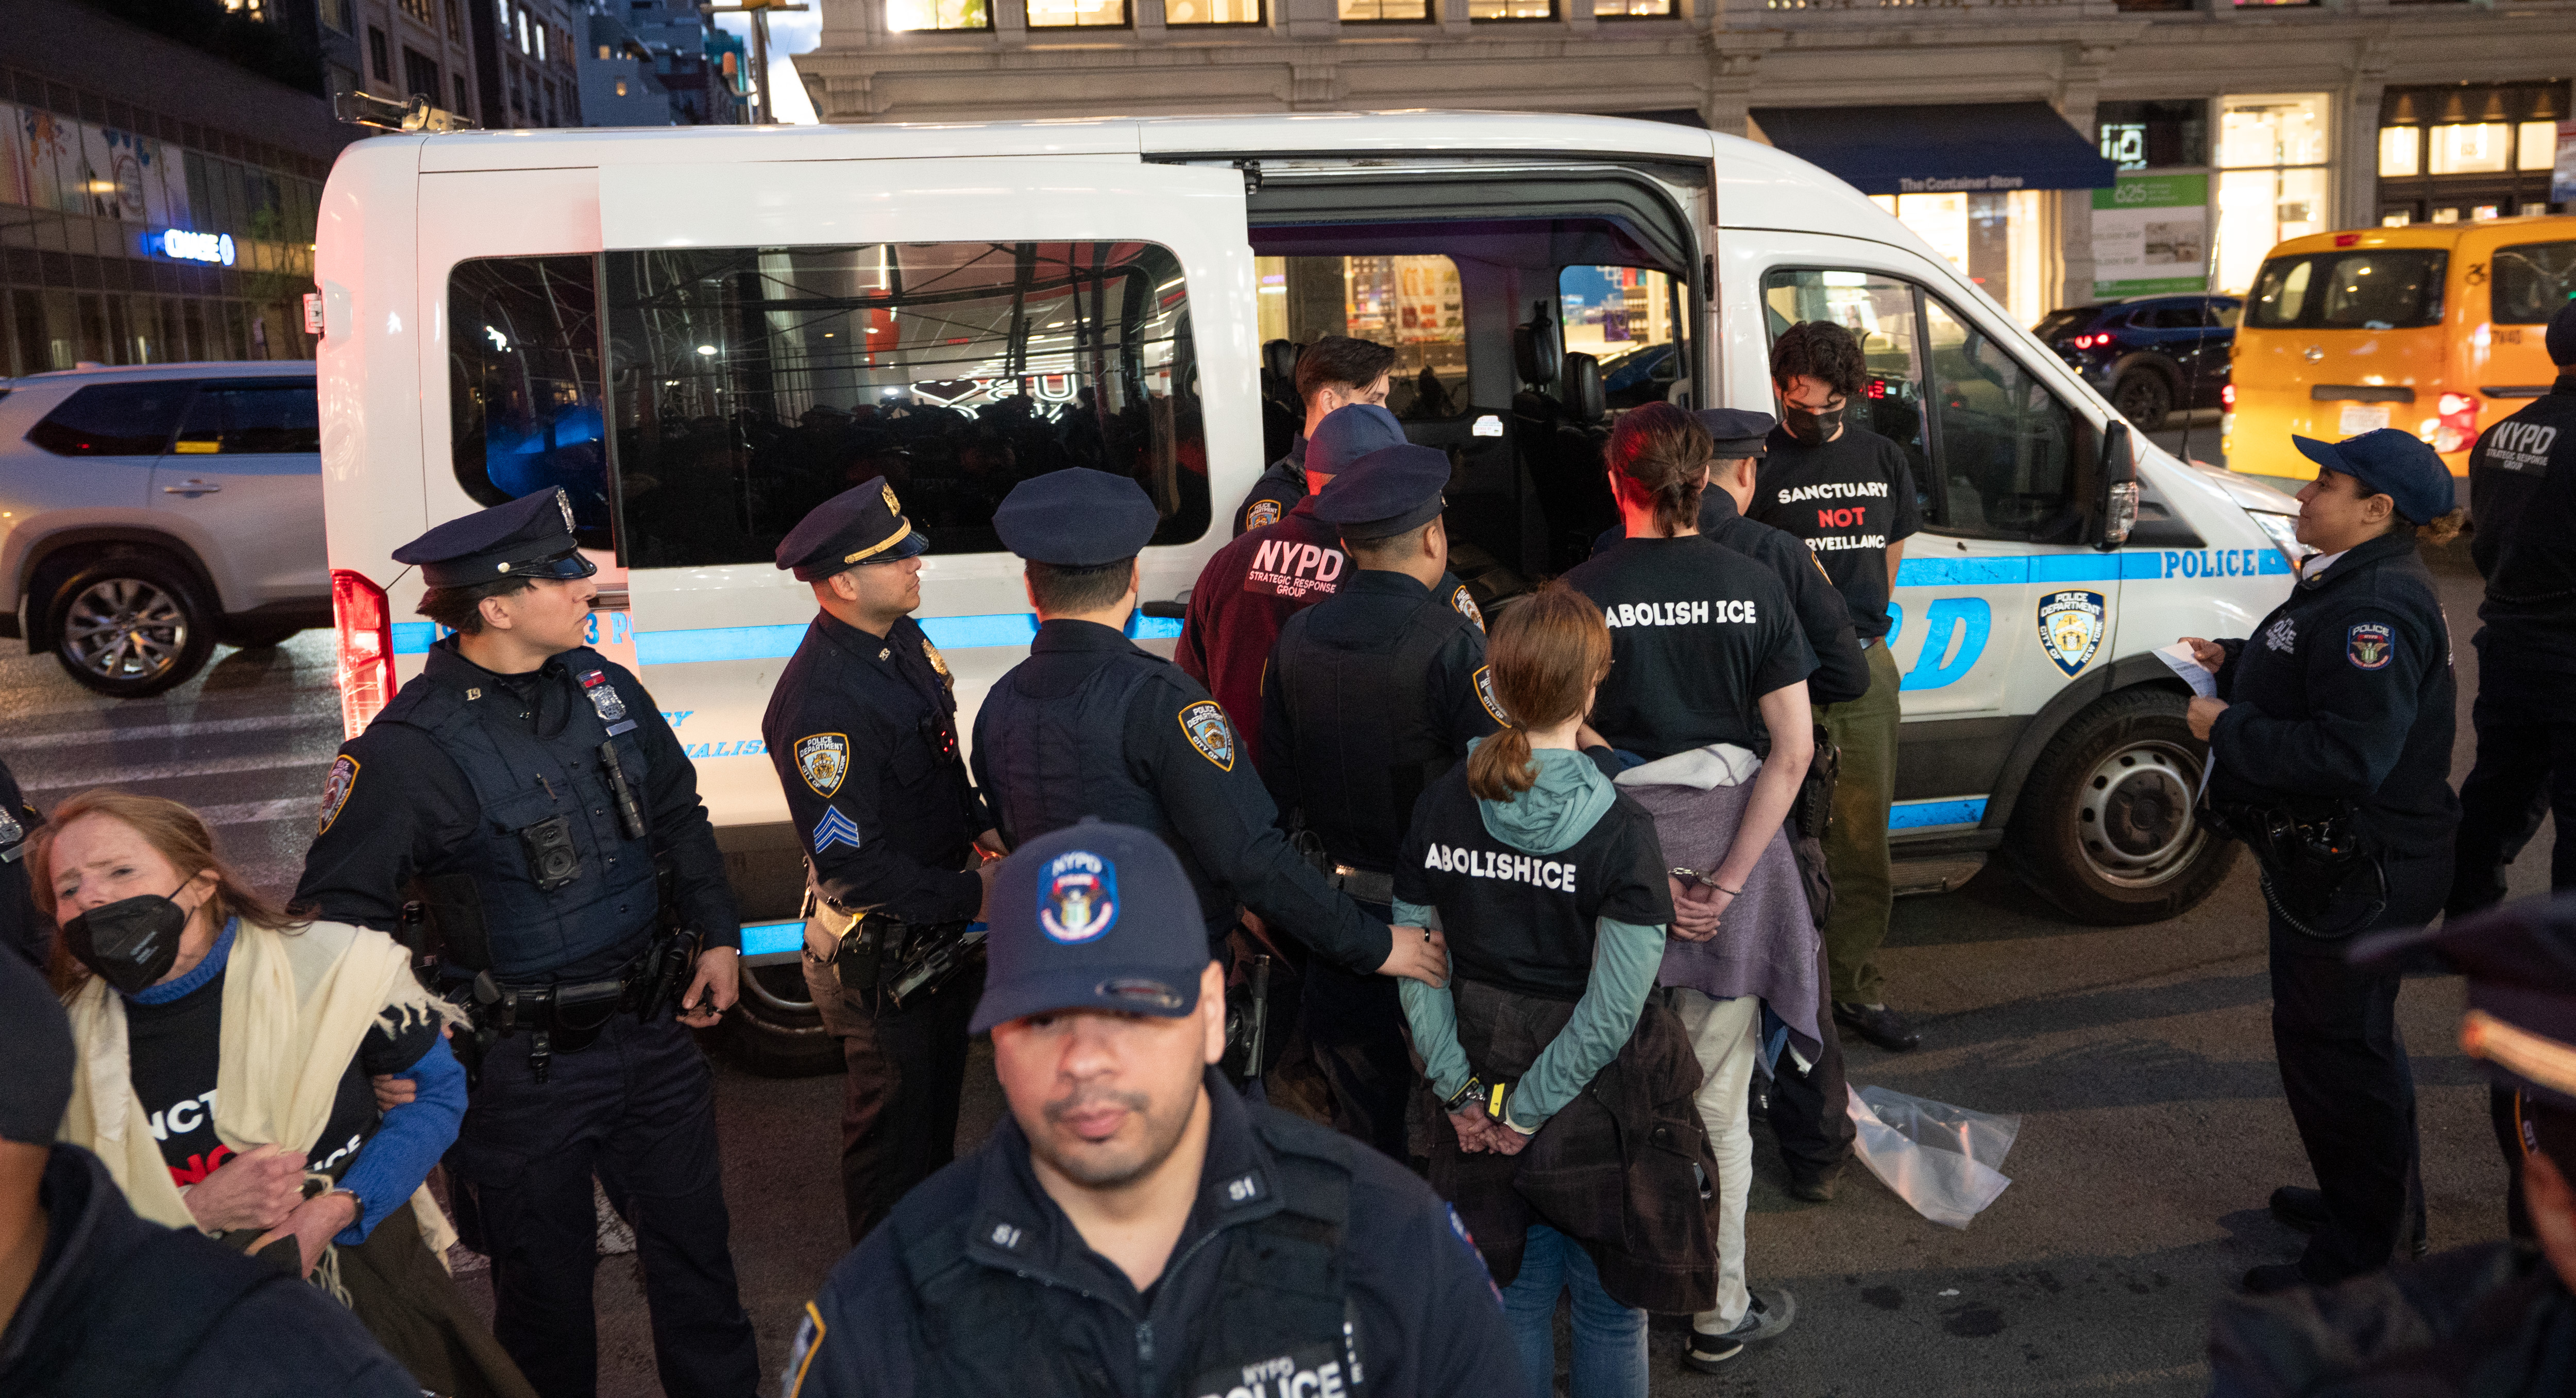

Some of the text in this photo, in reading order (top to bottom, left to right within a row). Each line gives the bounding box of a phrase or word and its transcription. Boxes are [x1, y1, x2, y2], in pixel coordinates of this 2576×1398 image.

[1925, 176, 1987, 191] Container
[1988, 174, 2023, 189] Store
[2115, 184, 2146, 203] 625
[2490, 421, 2556, 455] NYPD
[1778, 482, 1888, 504] SANCTUARY
[1818, 507, 1866, 528] NOT
[1805, 535, 1886, 551] RVEILLANC
[1252, 540, 1344, 582] NYPD
[2164, 550, 2255, 578] POLICE
[1249, 570, 1336, 594] STRATEGIC RESPONSE
[1276, 584, 1306, 598] GROUP
[2055, 592, 2089, 603] POLICE
[1605, 600, 1756, 629] ABOLISH ICE
[2041, 601, 2100, 617] DEPARTMENT
[2352, 624, 2389, 637] POLICE
[2039, 621, 2103, 663] CITY OF NEW YORK
[465, 687, 482, 701] 19
[1484, 696, 1496, 711] CITY
[1193, 705, 1216, 716] POLICE
[800, 743, 843, 758] DEPARTMENT
[807, 736, 833, 747] POLICE
[1192, 736, 1209, 751] CITY
[802, 765, 813, 780] CITY
[812, 780, 821, 788] OF
[837, 755, 846, 773] YORK
[1053, 851, 1101, 876] NYPD
[1229, 1176, 1256, 1201] SI
[992, 1223, 1022, 1249] SI
